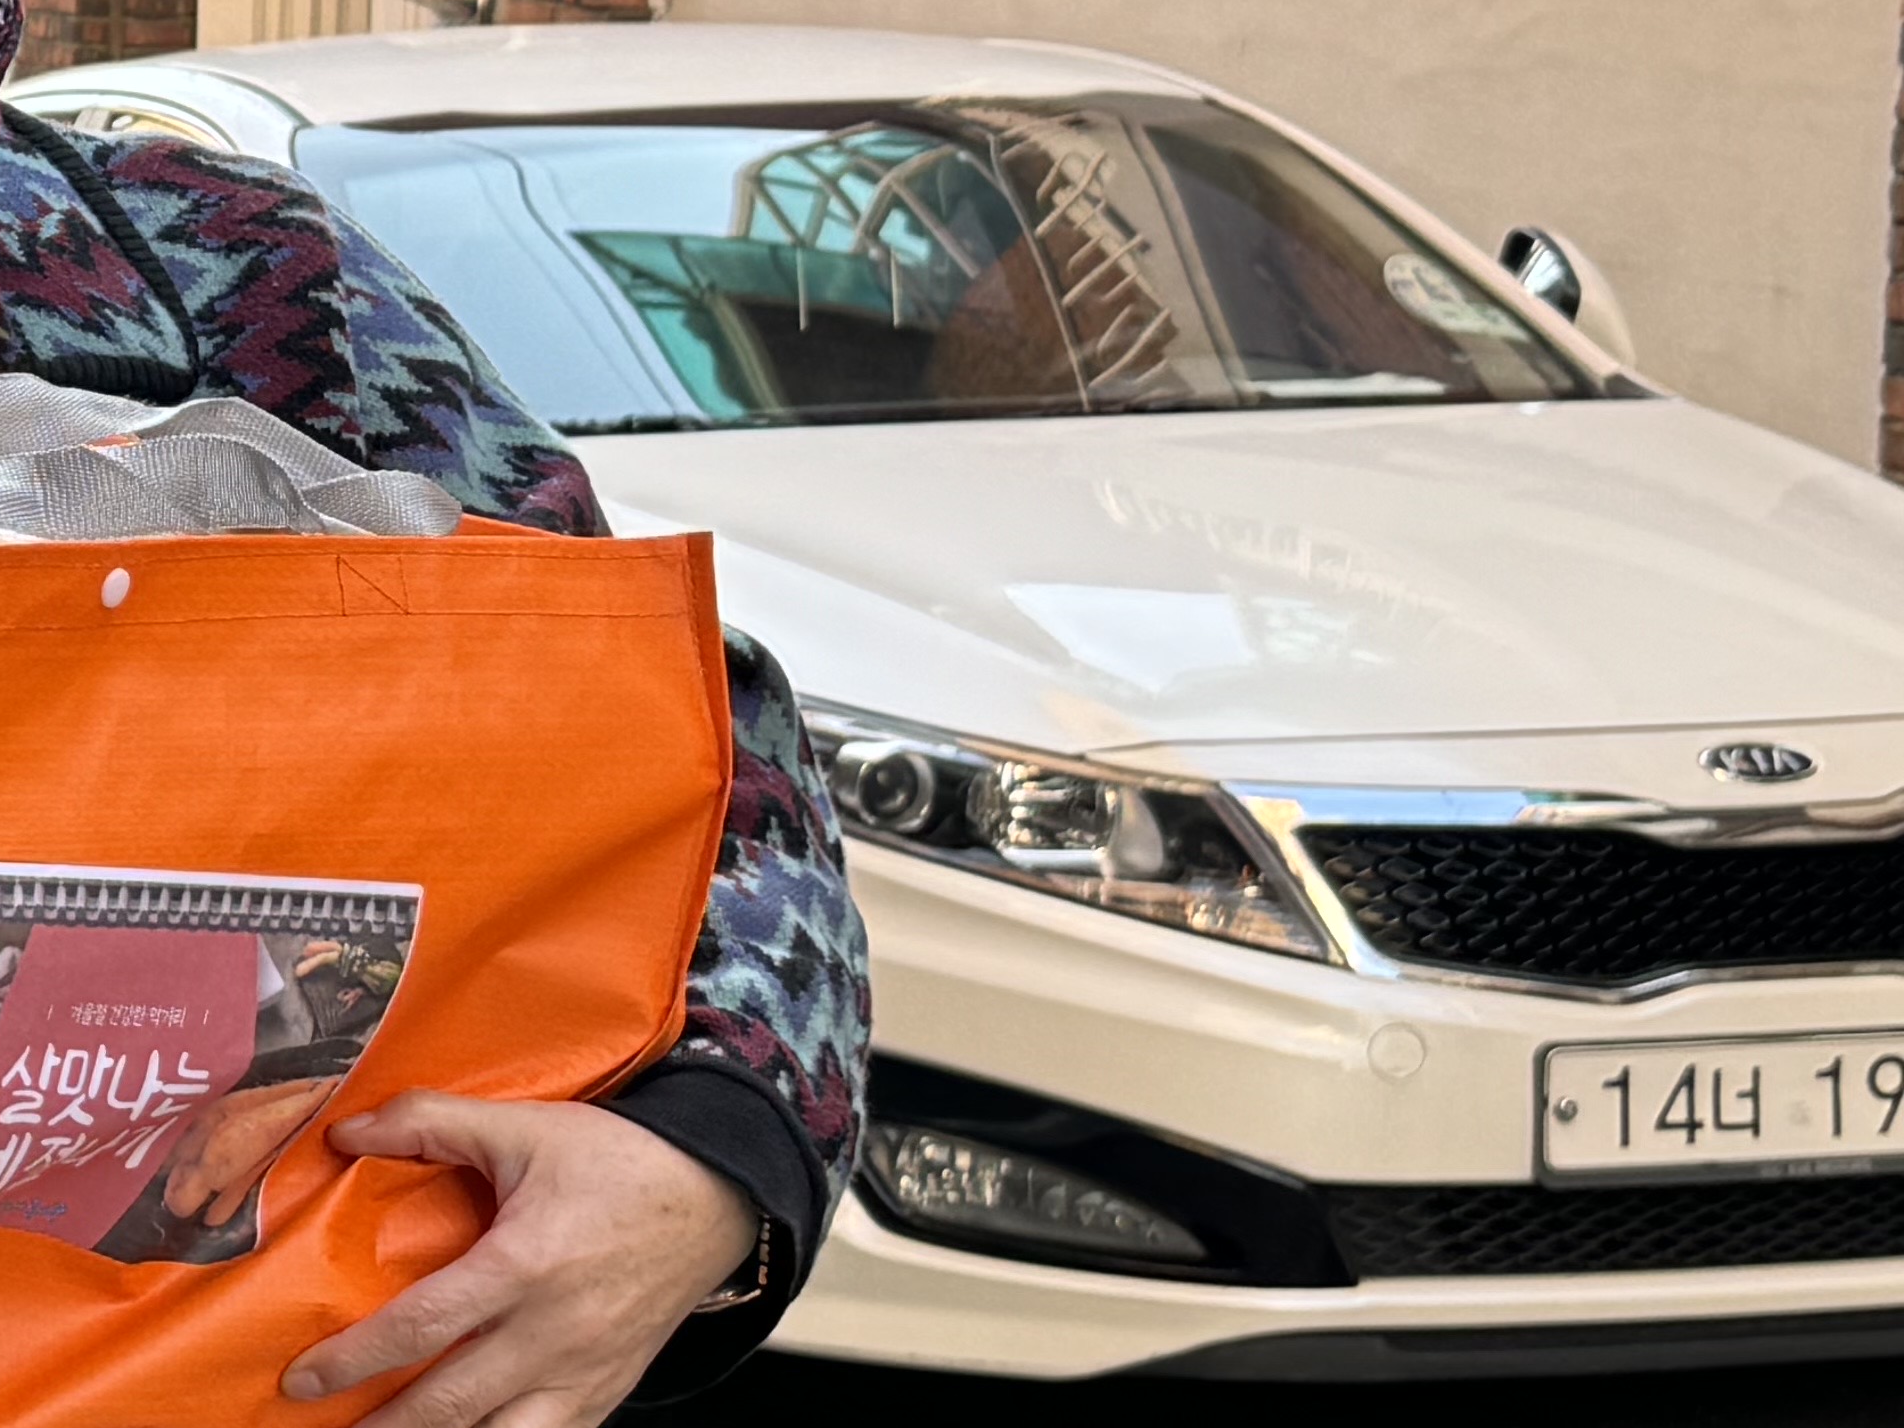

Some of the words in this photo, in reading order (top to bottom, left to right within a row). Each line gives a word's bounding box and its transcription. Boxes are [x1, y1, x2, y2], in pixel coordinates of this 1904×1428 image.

[111, 1004, 146, 1027] 건강한
[149, 1006, 186, 1028] 먹거리
[1602, 1062, 1760, 1149] 14너
